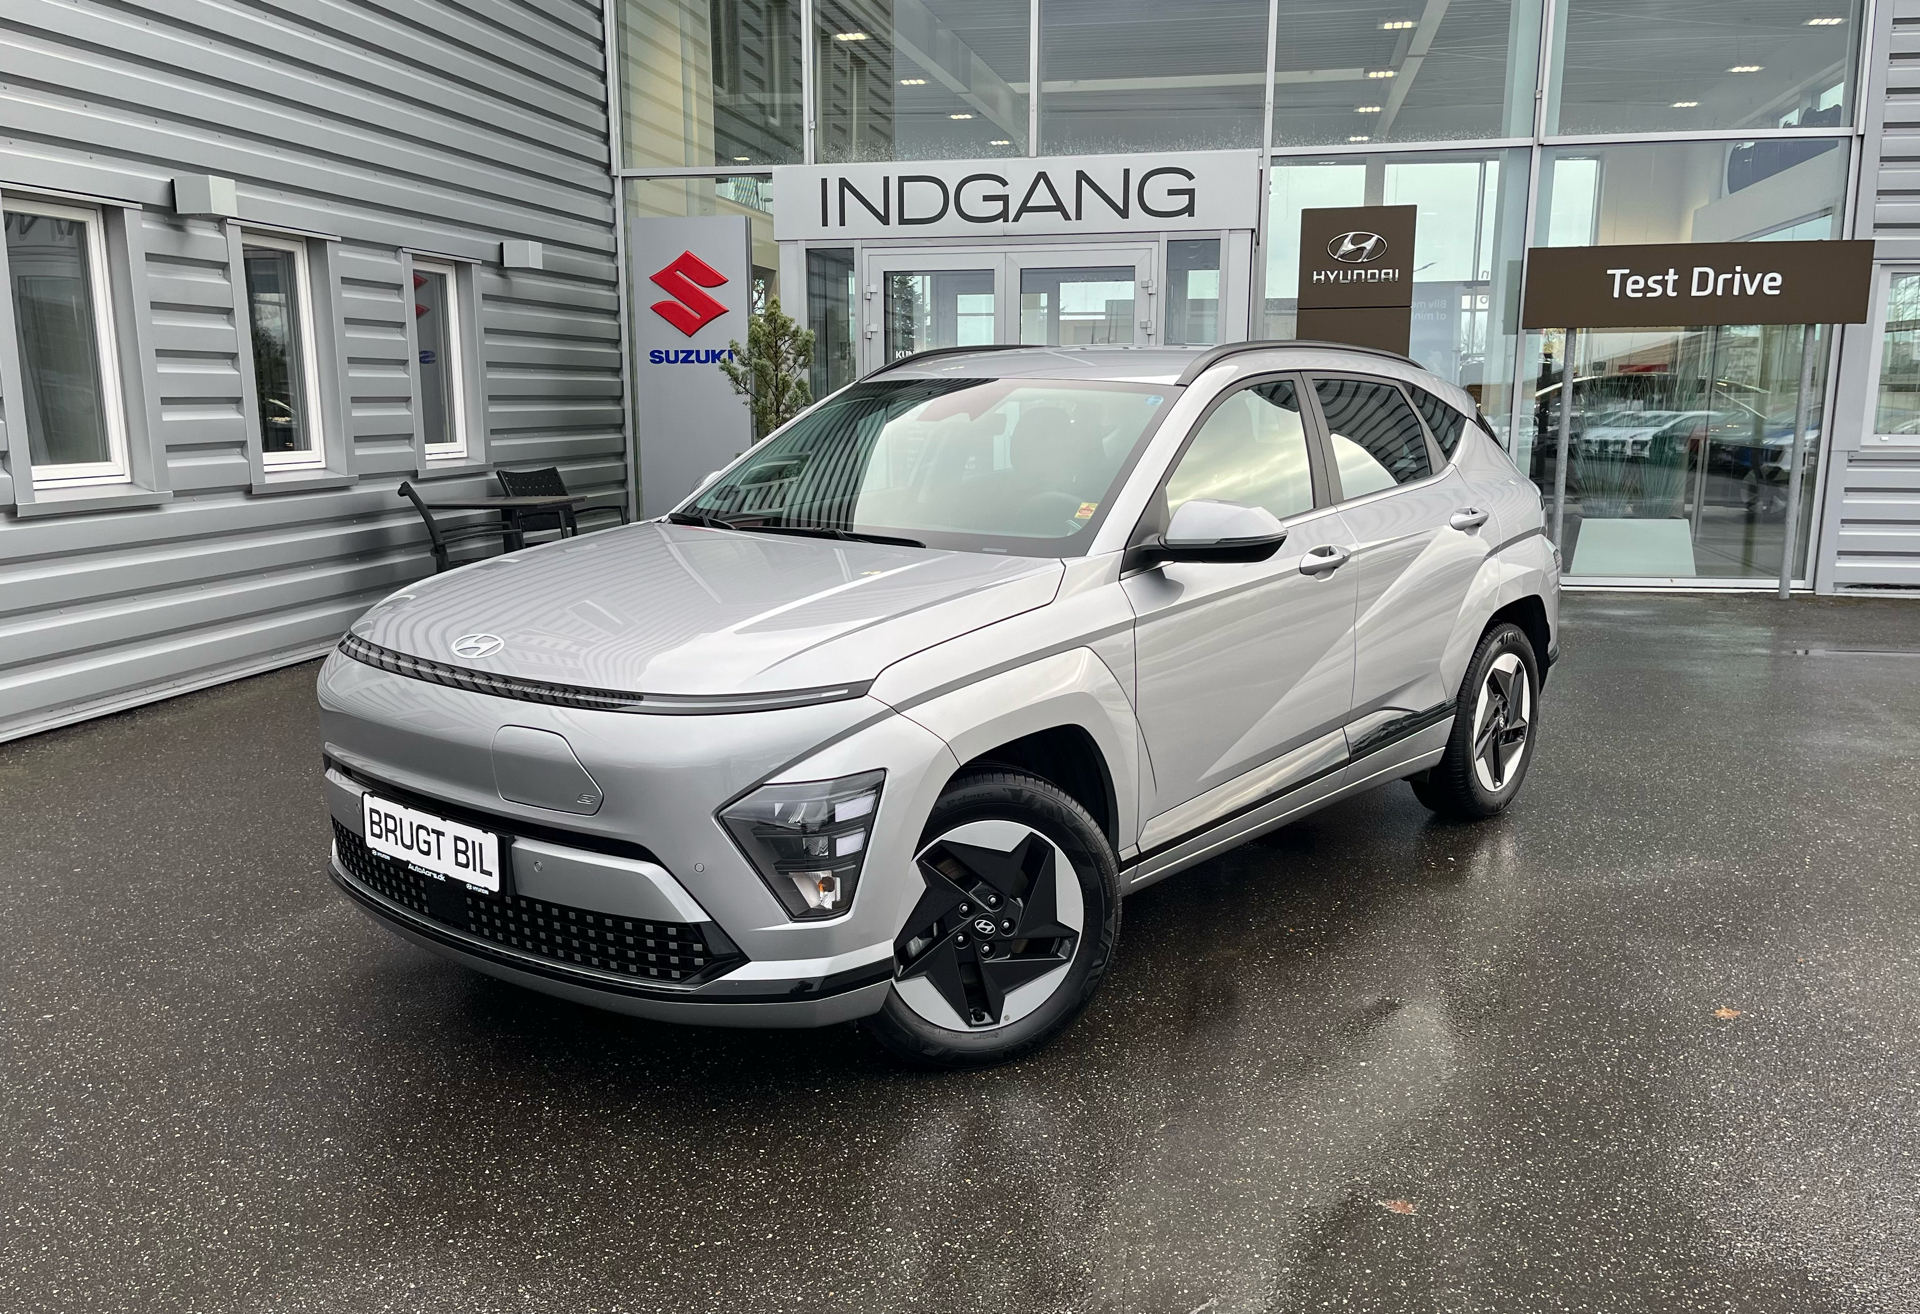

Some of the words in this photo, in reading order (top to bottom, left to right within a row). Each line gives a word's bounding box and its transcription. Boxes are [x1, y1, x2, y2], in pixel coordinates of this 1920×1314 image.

[820, 166, 1196, 227] INDGANG
[1312, 268, 1399, 284] HYUNDAI
[1606, 268, 1679, 299] Test
[1690, 265, 1783, 297] Drive
[649, 349, 734, 365] SUZUKI
[368, 807, 446, 861] BRUGT
[453, 834, 494, 878] BIL
